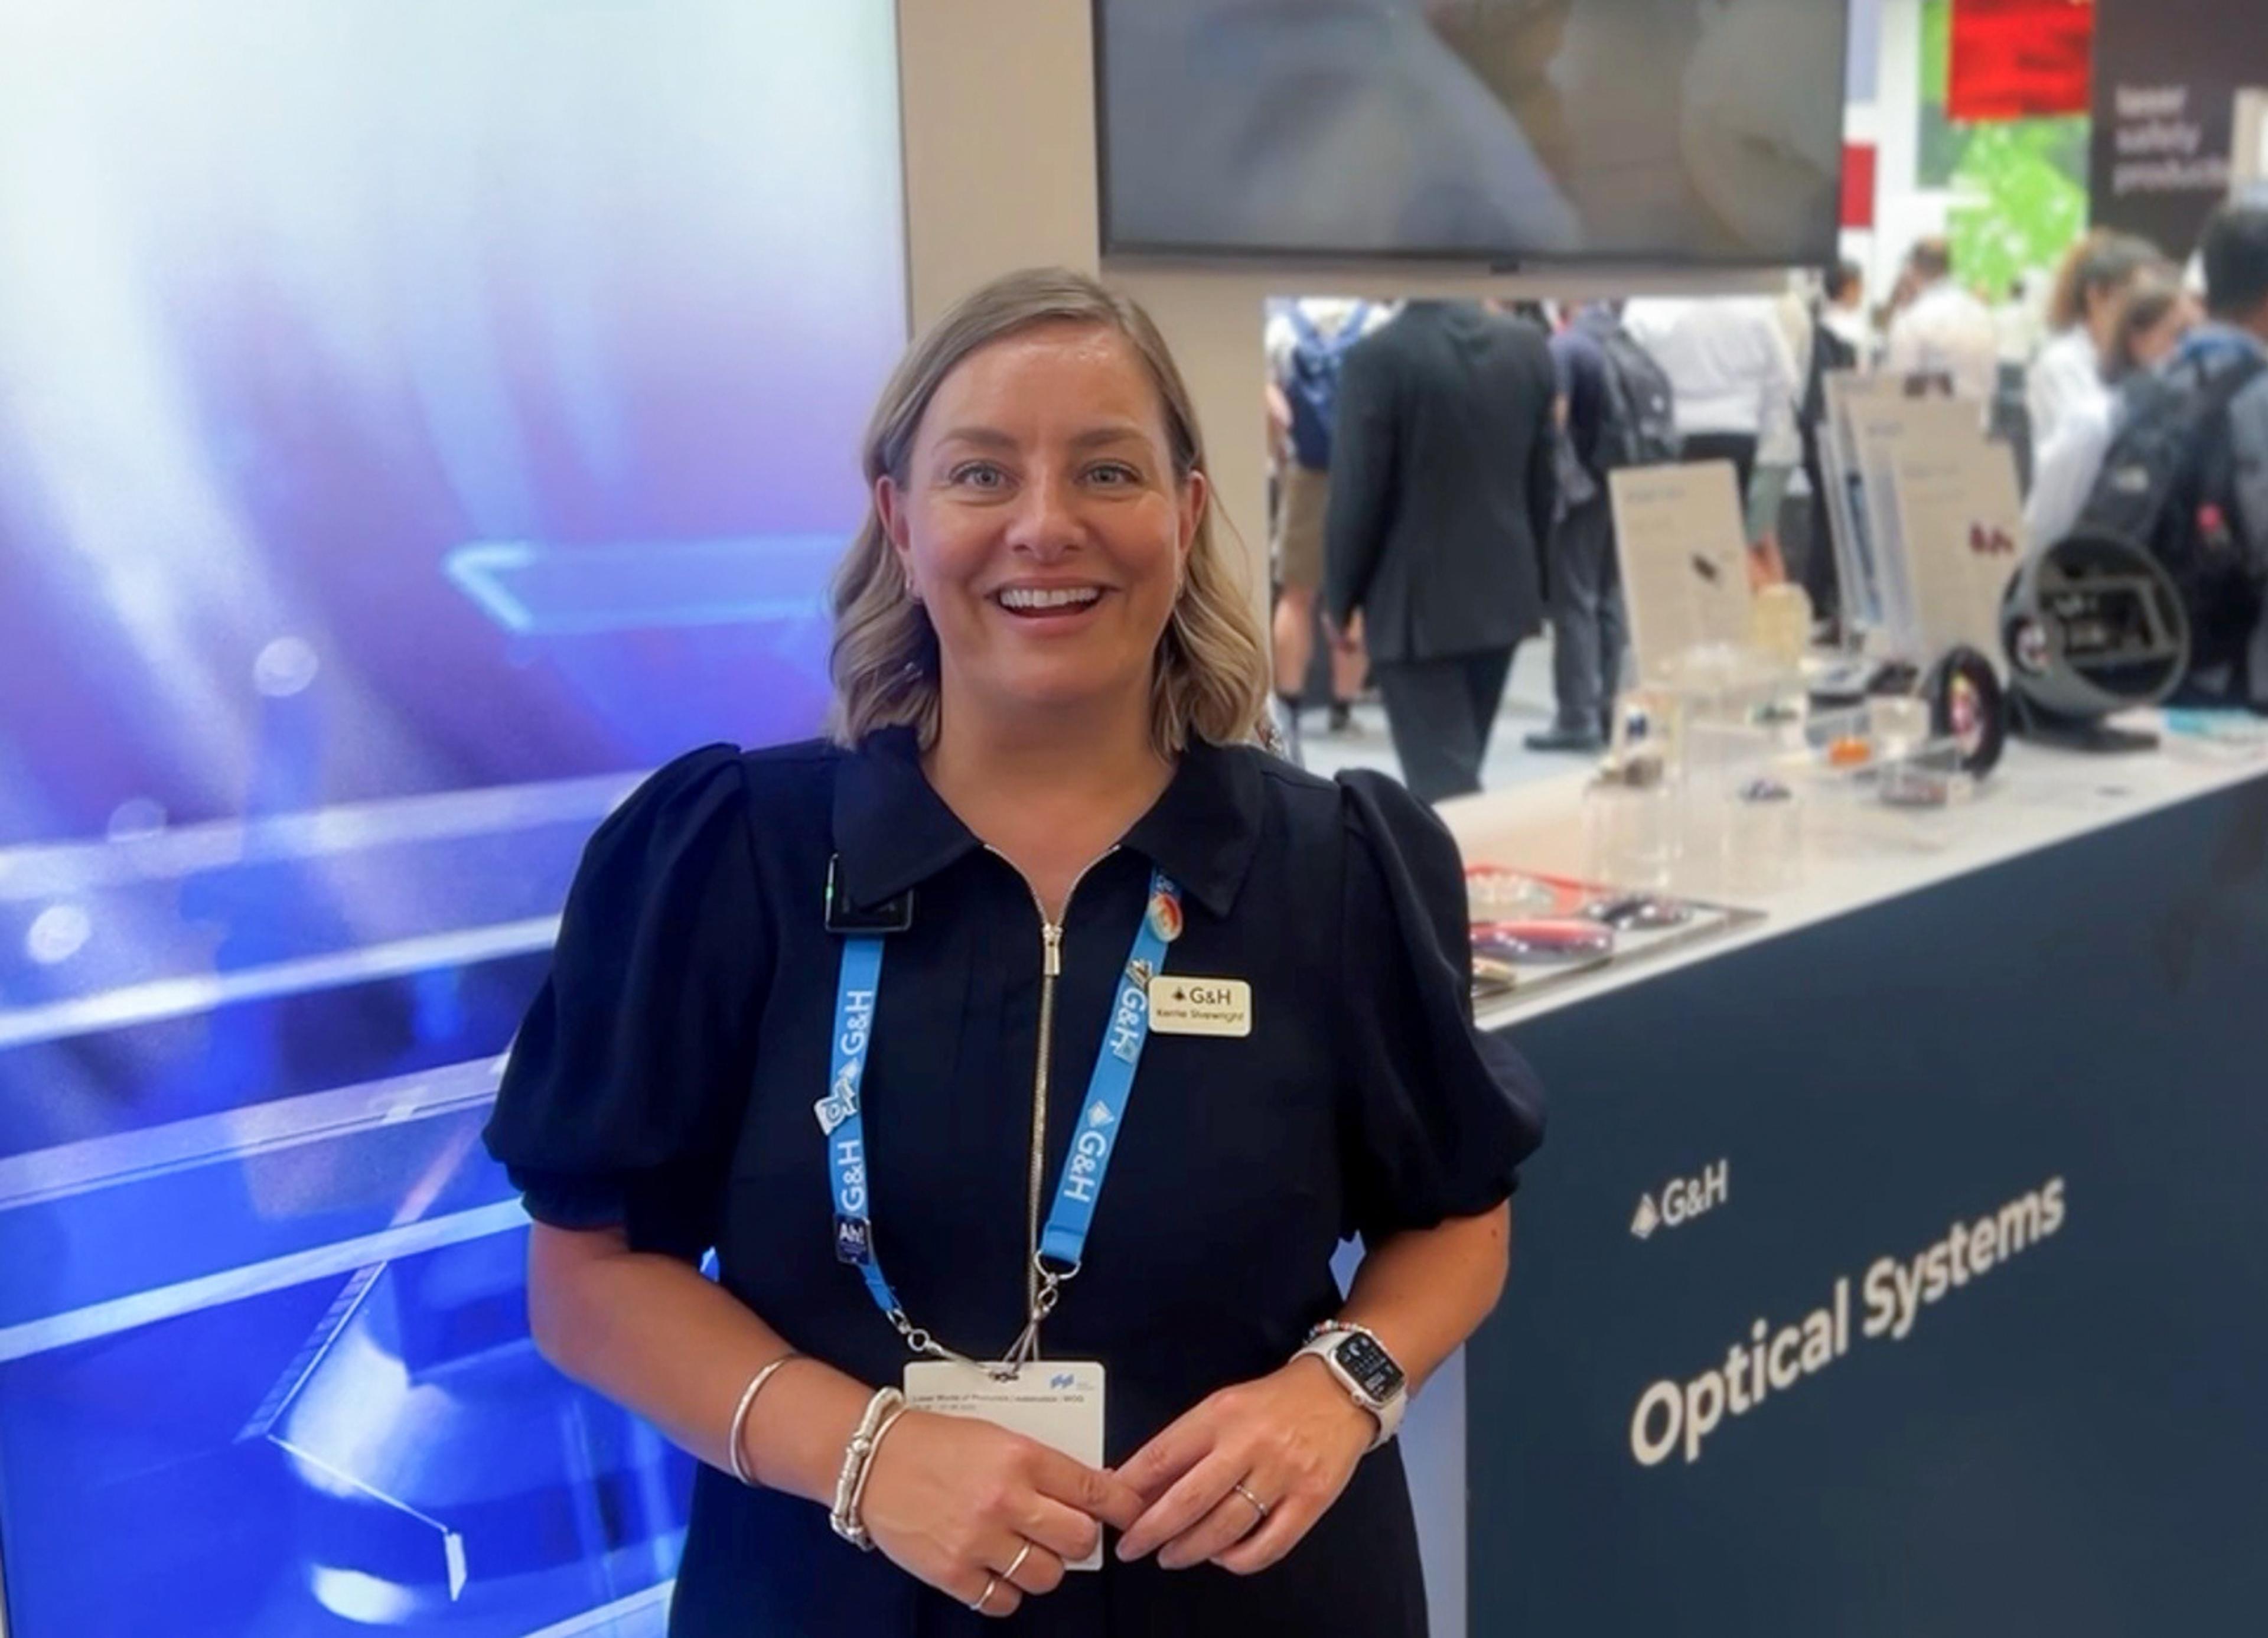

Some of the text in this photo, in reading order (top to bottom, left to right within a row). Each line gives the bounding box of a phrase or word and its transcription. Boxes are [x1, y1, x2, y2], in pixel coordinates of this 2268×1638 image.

[840, 991, 872, 1056] G&H
[1110, 987, 1146, 1055] G&H
[1190, 986, 1231, 1005] G&H
[838, 1139, 865, 1211] G&H
[1064, 1131, 1106, 1202] G&H
[1661, 1158, 1727, 1226] G&H
[1631, 1176, 2065, 1466] Optical Systems
